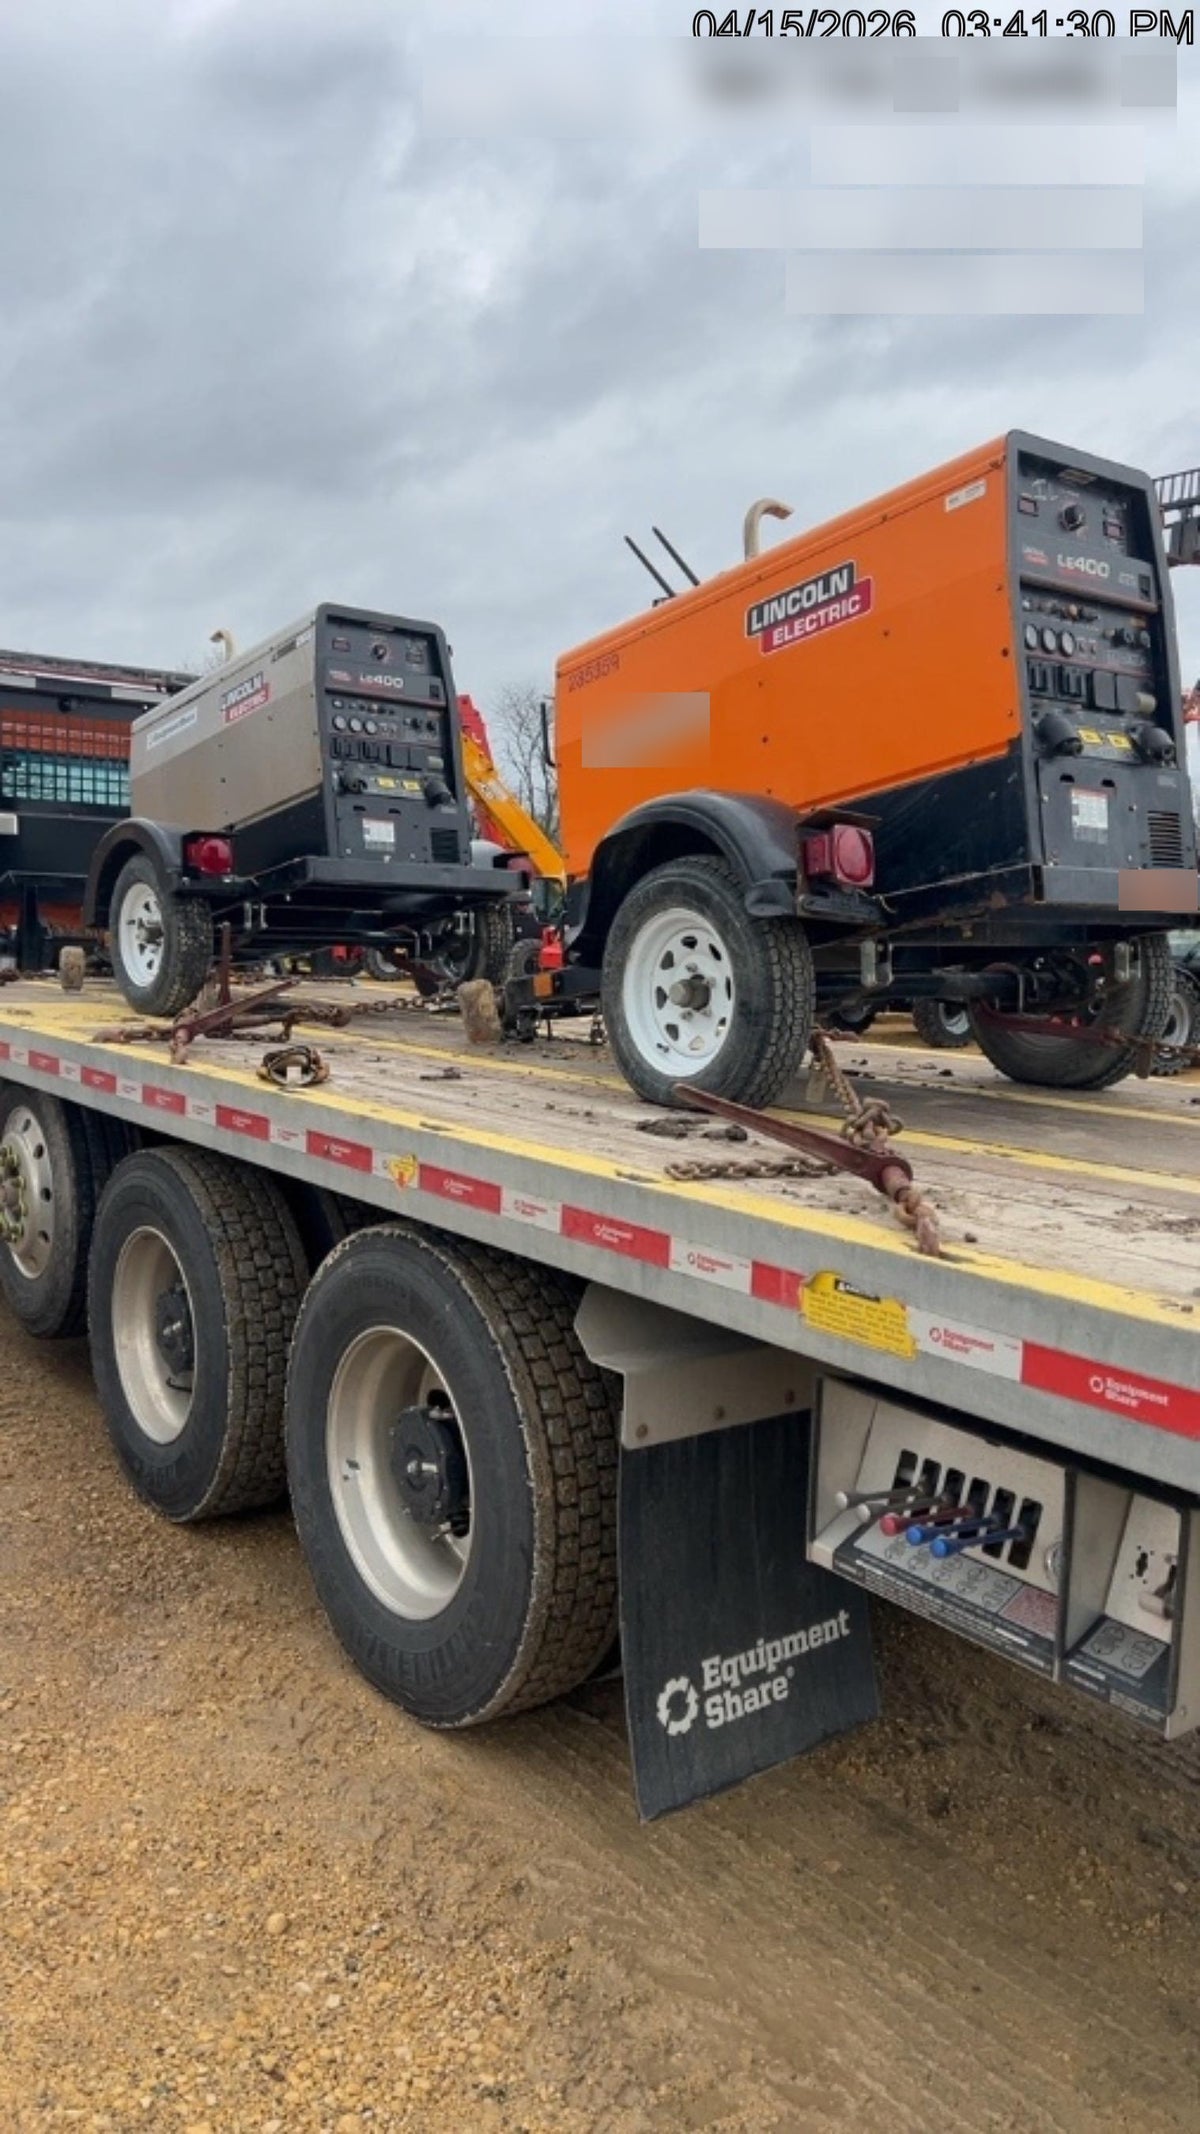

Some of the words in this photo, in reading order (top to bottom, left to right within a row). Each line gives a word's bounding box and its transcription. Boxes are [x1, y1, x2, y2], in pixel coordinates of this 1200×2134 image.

[751, 568, 849, 632] LINCOLN
[772, 594, 861, 647] ELECTRIC
[1105, 1376, 1169, 1407] Equipment
[702, 1608, 850, 1691] Equipment
